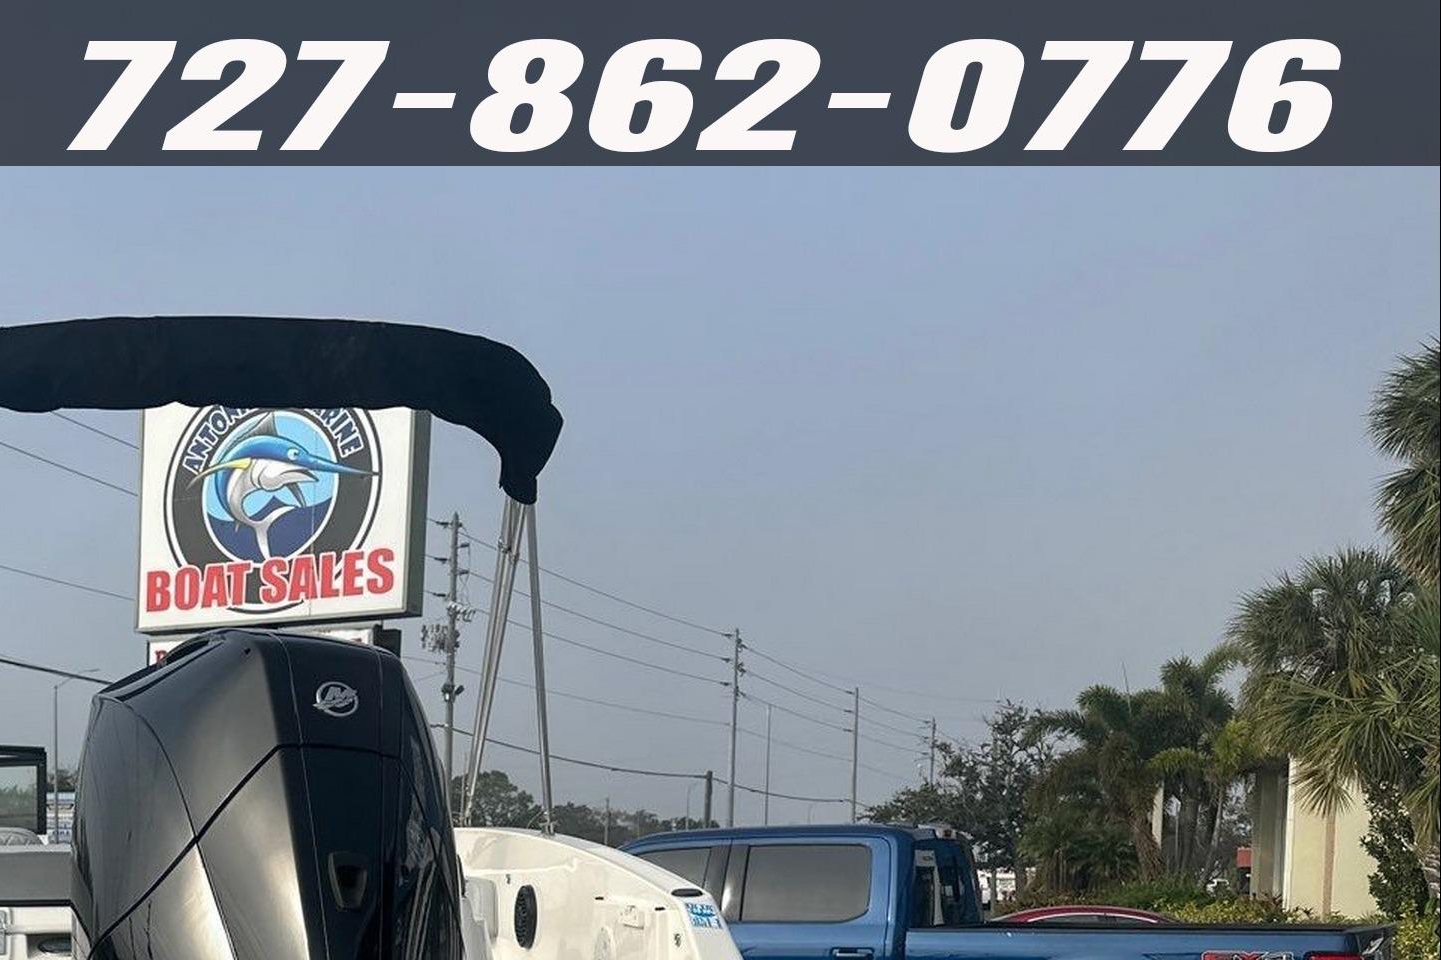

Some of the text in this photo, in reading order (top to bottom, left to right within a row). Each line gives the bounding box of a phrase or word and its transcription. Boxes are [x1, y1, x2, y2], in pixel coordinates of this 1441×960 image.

[182, 405, 365, 475] ANTON RINE
[146, 547, 395, 613] BOAT SALES
